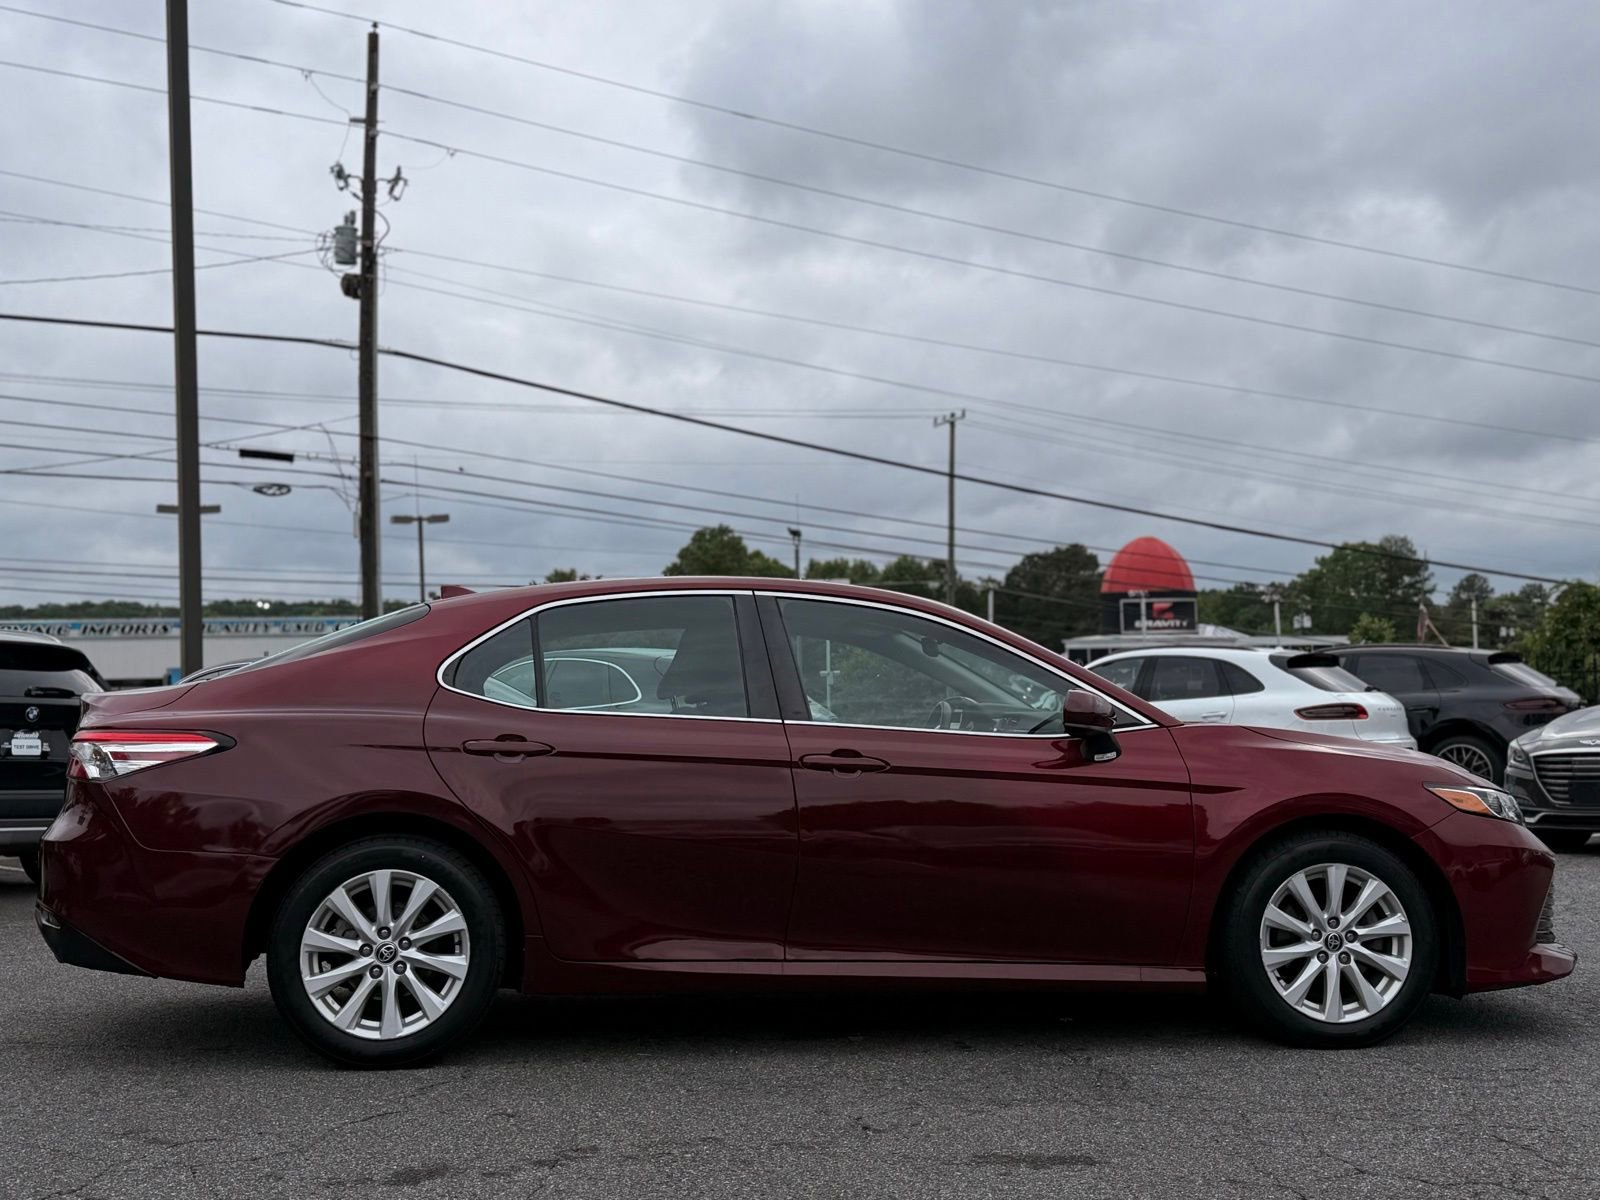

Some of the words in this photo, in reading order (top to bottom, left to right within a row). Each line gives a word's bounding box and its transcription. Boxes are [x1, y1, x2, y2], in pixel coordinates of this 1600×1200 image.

[81, 622, 171, 635] IMPORTS
[202, 622, 271, 634] UALITY
[280, 622, 326, 634] USED
